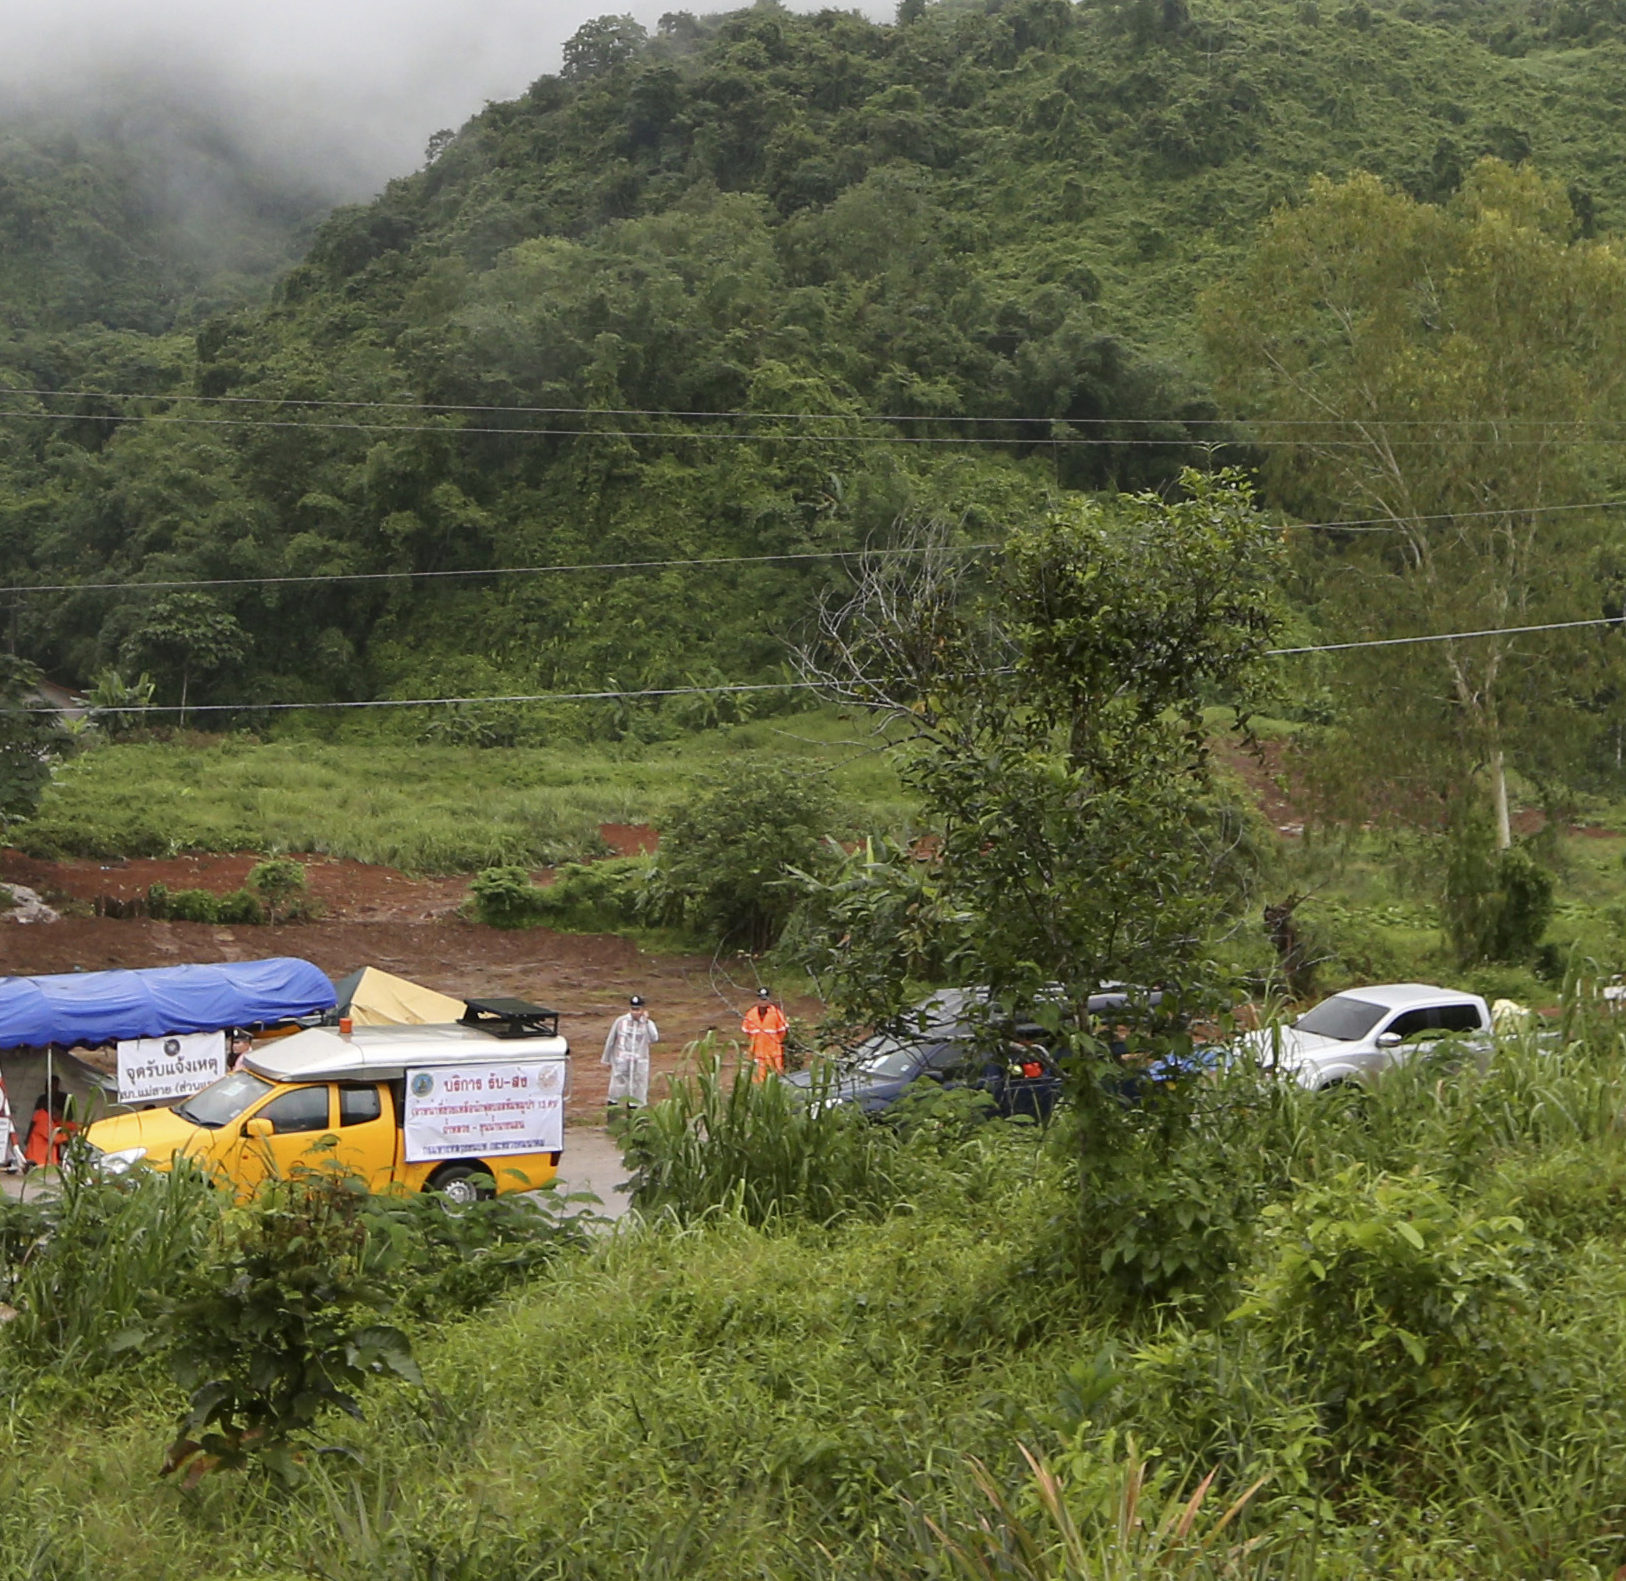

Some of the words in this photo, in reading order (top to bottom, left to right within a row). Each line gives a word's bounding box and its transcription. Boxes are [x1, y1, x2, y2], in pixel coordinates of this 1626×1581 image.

[126, 1055, 218, 1086] จุดรับแจ้งเหตุ
[444, 1074, 483, 1093] บริการ
